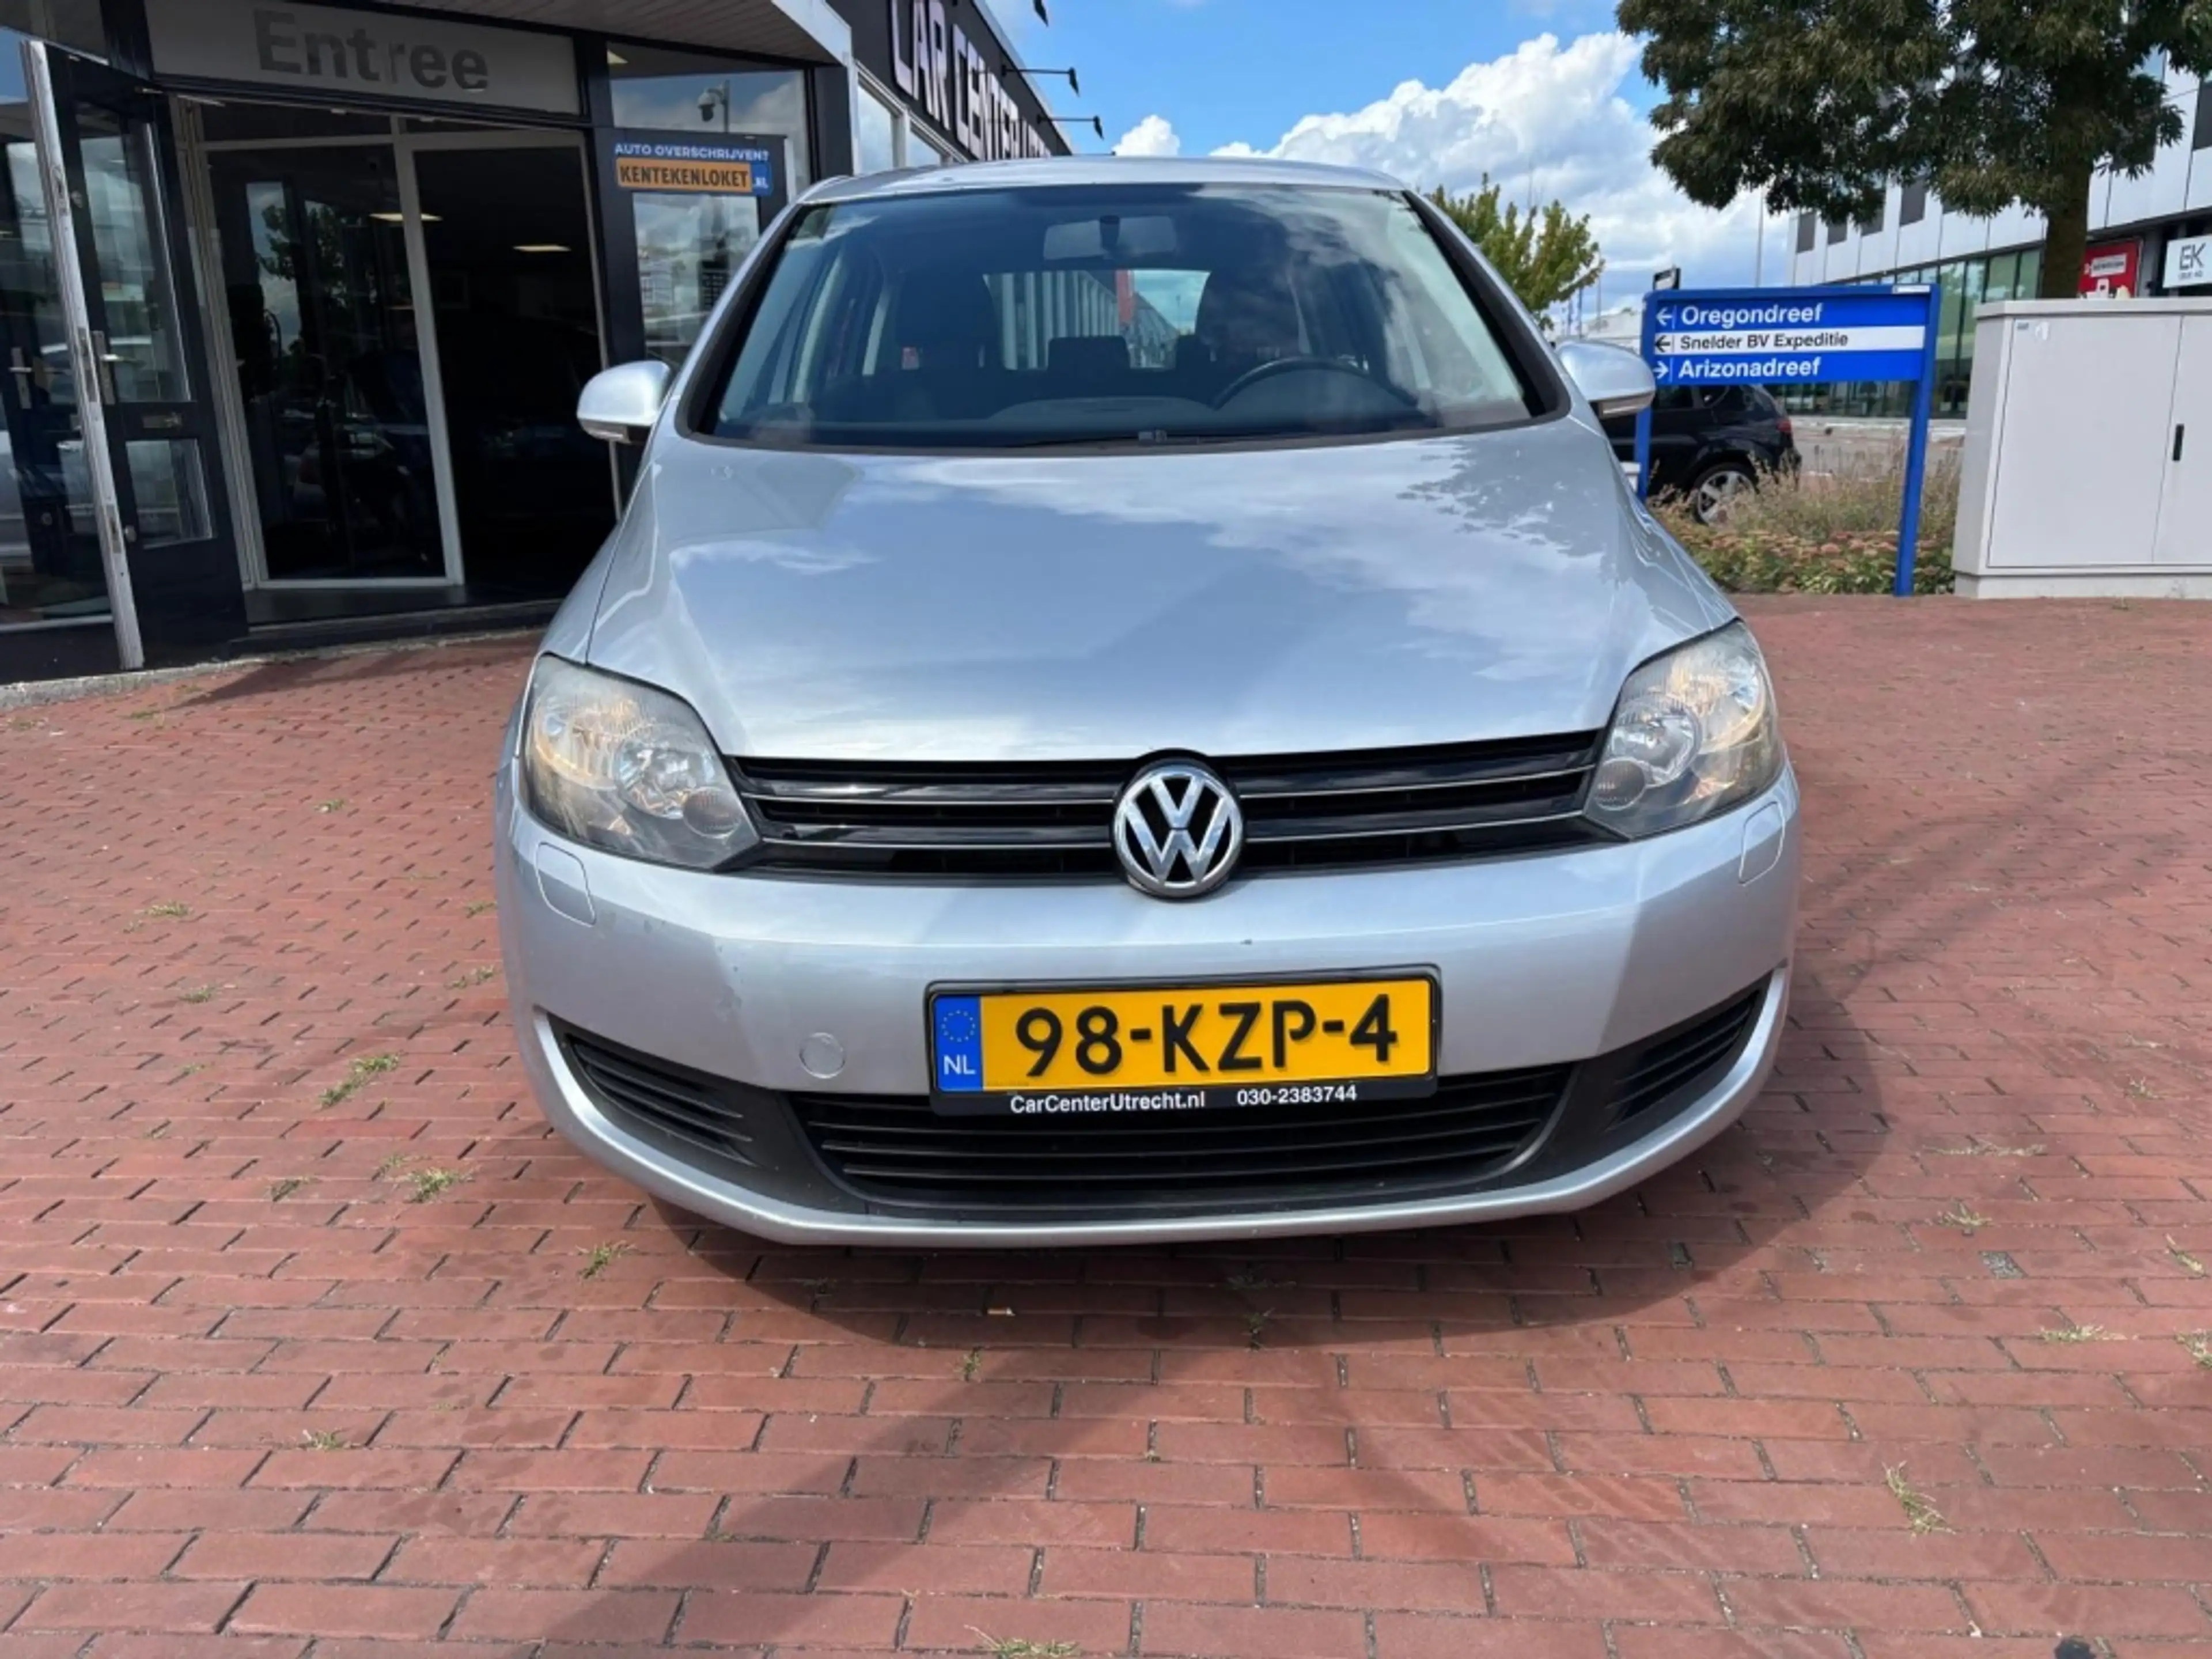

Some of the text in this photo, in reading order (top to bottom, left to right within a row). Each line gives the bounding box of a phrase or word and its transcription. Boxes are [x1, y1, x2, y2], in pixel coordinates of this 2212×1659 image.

[253, 7, 488, 90] Entree
[615, 144, 652, 155] AUTO
[2179, 243, 2206, 271] EK
[1681, 302, 1823, 329] Oregondreef
[1680, 332, 1849, 350] Snelder BV Expeditie
[1678, 356, 1822, 378] Arizonadreef
[1016, 994, 1398, 1077] 98-KZP-4
[943, 1055, 976, 1075] NL
[1010, 1084, 1357, 1113] CarCenterUtrecht.nl 030-2383744
